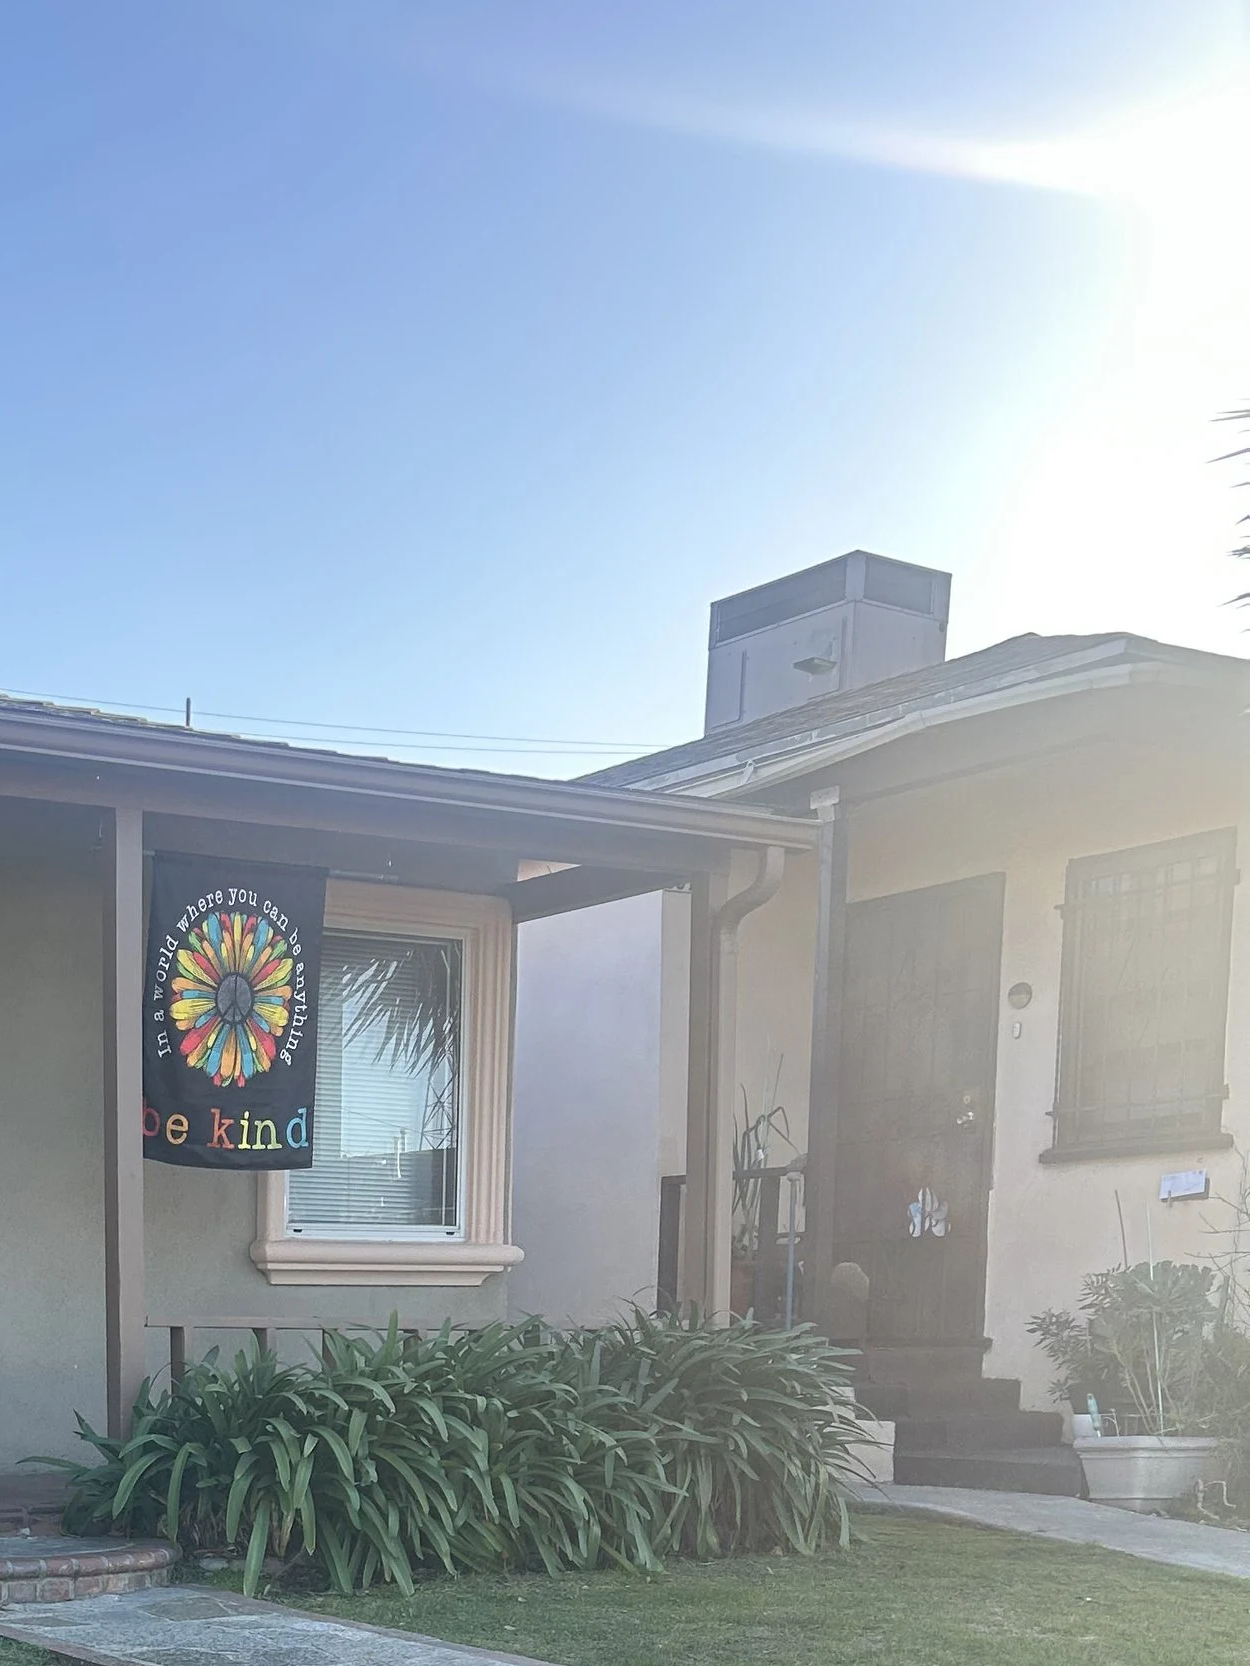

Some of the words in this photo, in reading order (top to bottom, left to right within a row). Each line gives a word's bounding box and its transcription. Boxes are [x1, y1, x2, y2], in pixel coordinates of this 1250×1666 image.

[176, 889, 224, 933] where
[228, 887, 258, 907] you
[262, 899, 289, 932] can
[288, 926, 302, 956] be
[153, 934, 179, 1001] world
[154, 1009, 165, 1021] a
[279, 962, 309, 1067] anything
[156, 1030, 172, 1058] In
[142, 1097, 190, 1146] be
[206, 1106, 310, 1150] kind
